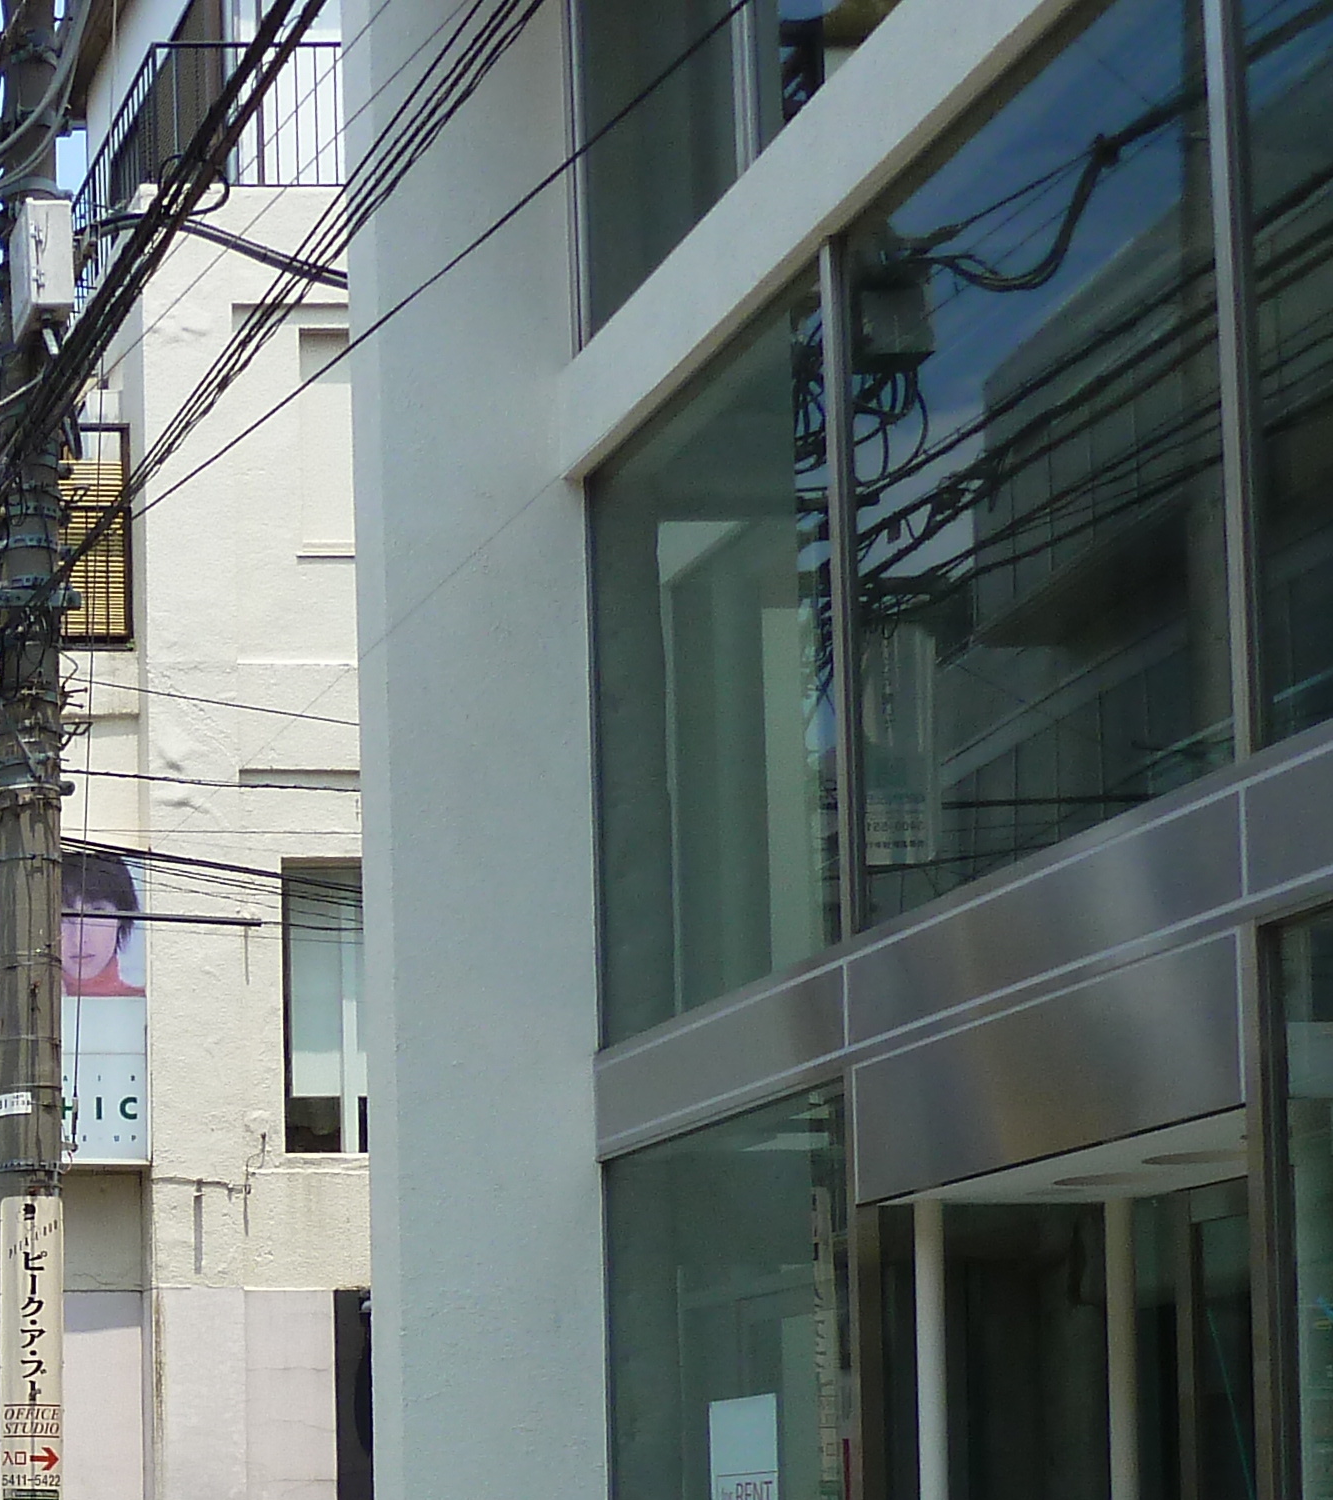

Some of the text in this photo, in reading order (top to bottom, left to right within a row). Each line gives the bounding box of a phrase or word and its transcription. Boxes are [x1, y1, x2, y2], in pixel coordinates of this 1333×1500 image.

[3, 1407, 61, 1421] OFFICE
[3, 1421, 60, 1435] STUDIO
[2, 1450, 27, 1466] 入口
[1, 1474, 61, 1487] 5411-5422
